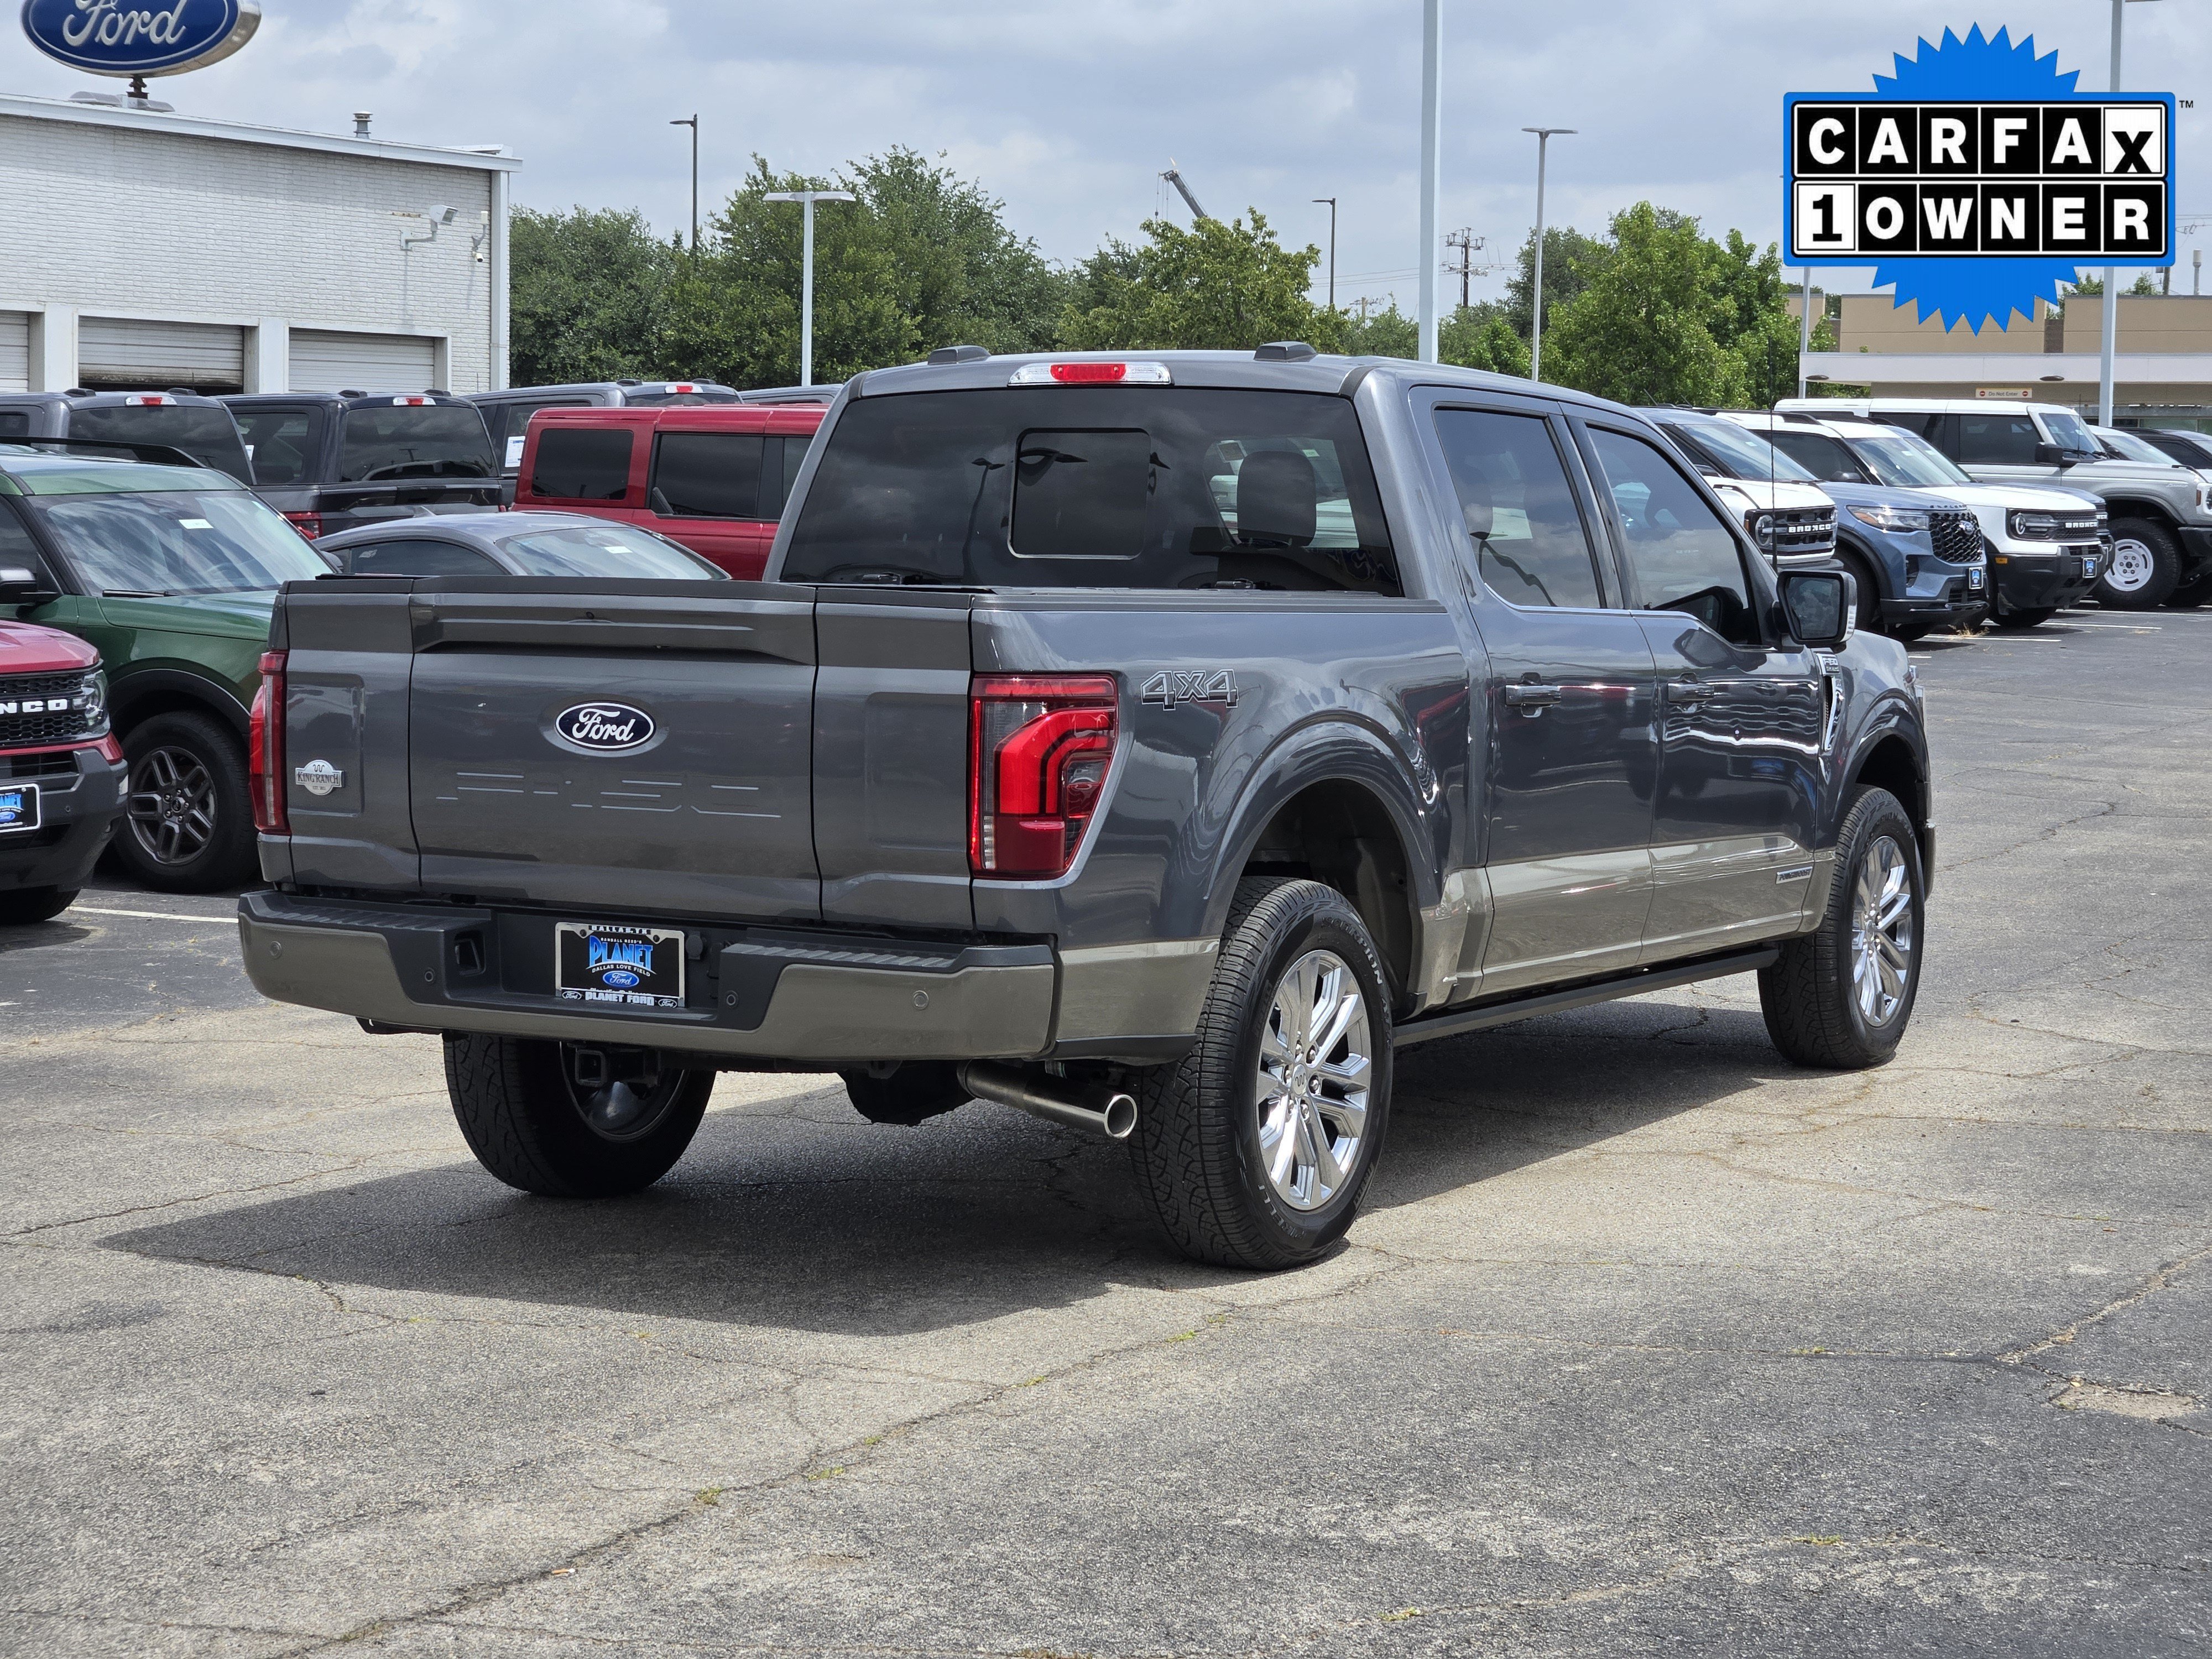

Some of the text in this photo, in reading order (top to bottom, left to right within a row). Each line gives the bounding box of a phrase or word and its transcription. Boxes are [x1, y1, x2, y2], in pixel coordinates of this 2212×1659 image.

[62, 0, 187, 46] Ford
[1788, 523, 1832, 533] BRONCO
[572, 708, 635, 741] Ford
[298, 771, 338, 784] KING RANCH
[589, 935, 653, 971] PLANET
[592, 964, 614, 973] DALLAS
[634, 967, 650, 977] FIELD
[609, 972, 632, 985] Ford
[585, 992, 624, 1003] PLANET
[627, 995, 654, 1006] FORD
